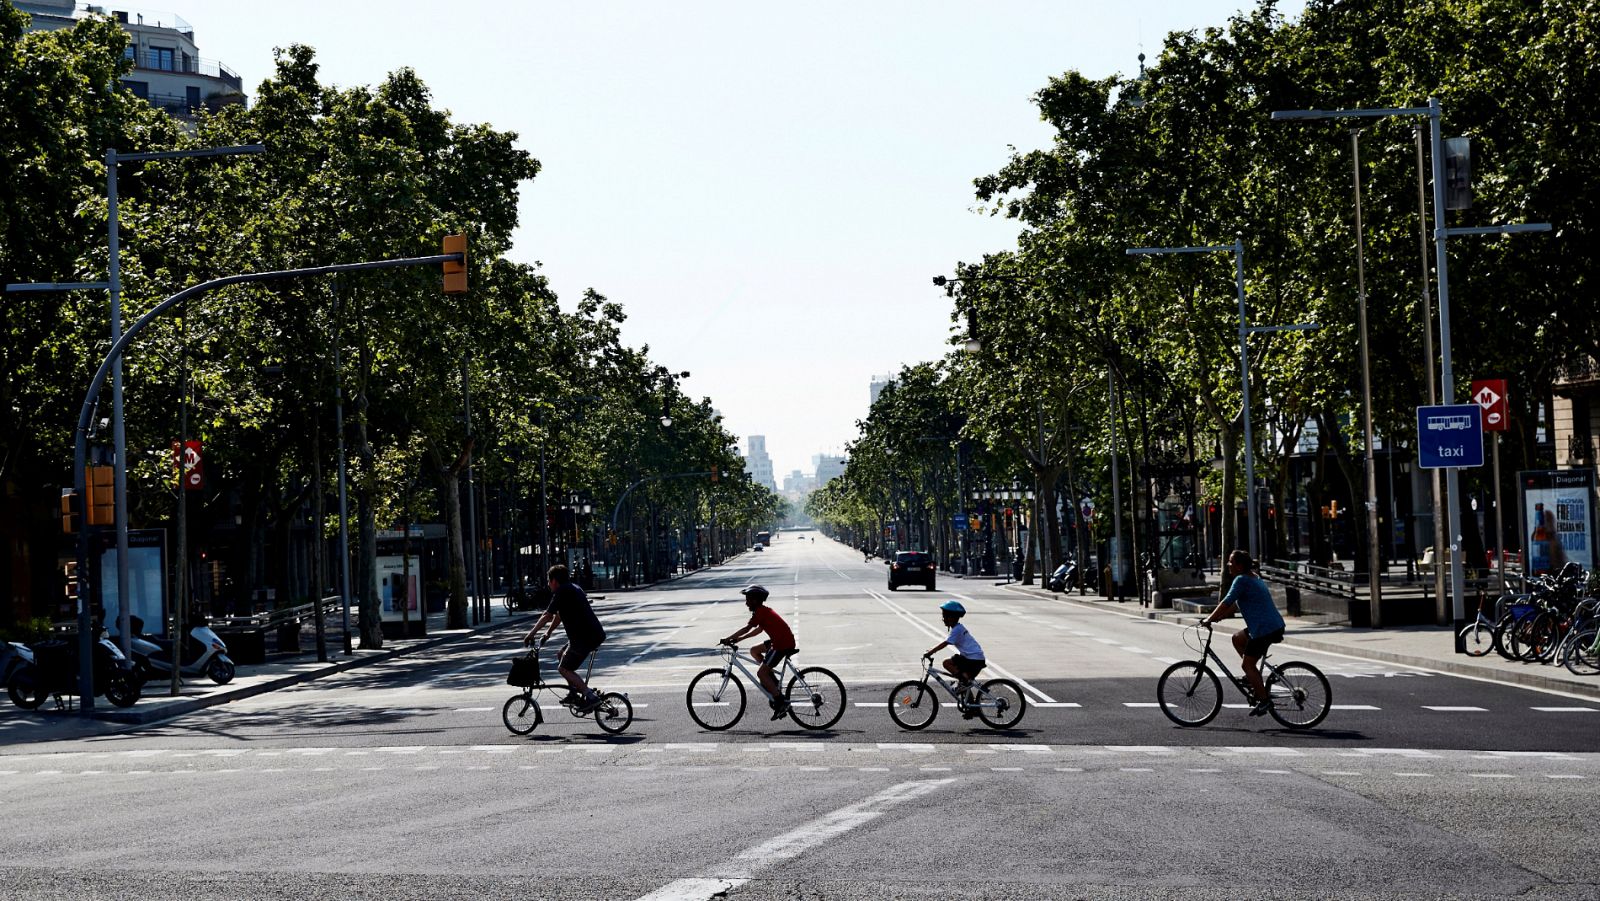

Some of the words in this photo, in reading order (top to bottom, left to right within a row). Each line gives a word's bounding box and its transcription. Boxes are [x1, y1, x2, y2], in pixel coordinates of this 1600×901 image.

[1481, 393, 1492, 404] M
[1438, 445, 1464, 457] taxi
[1556, 475, 1587, 484] Diagonal
